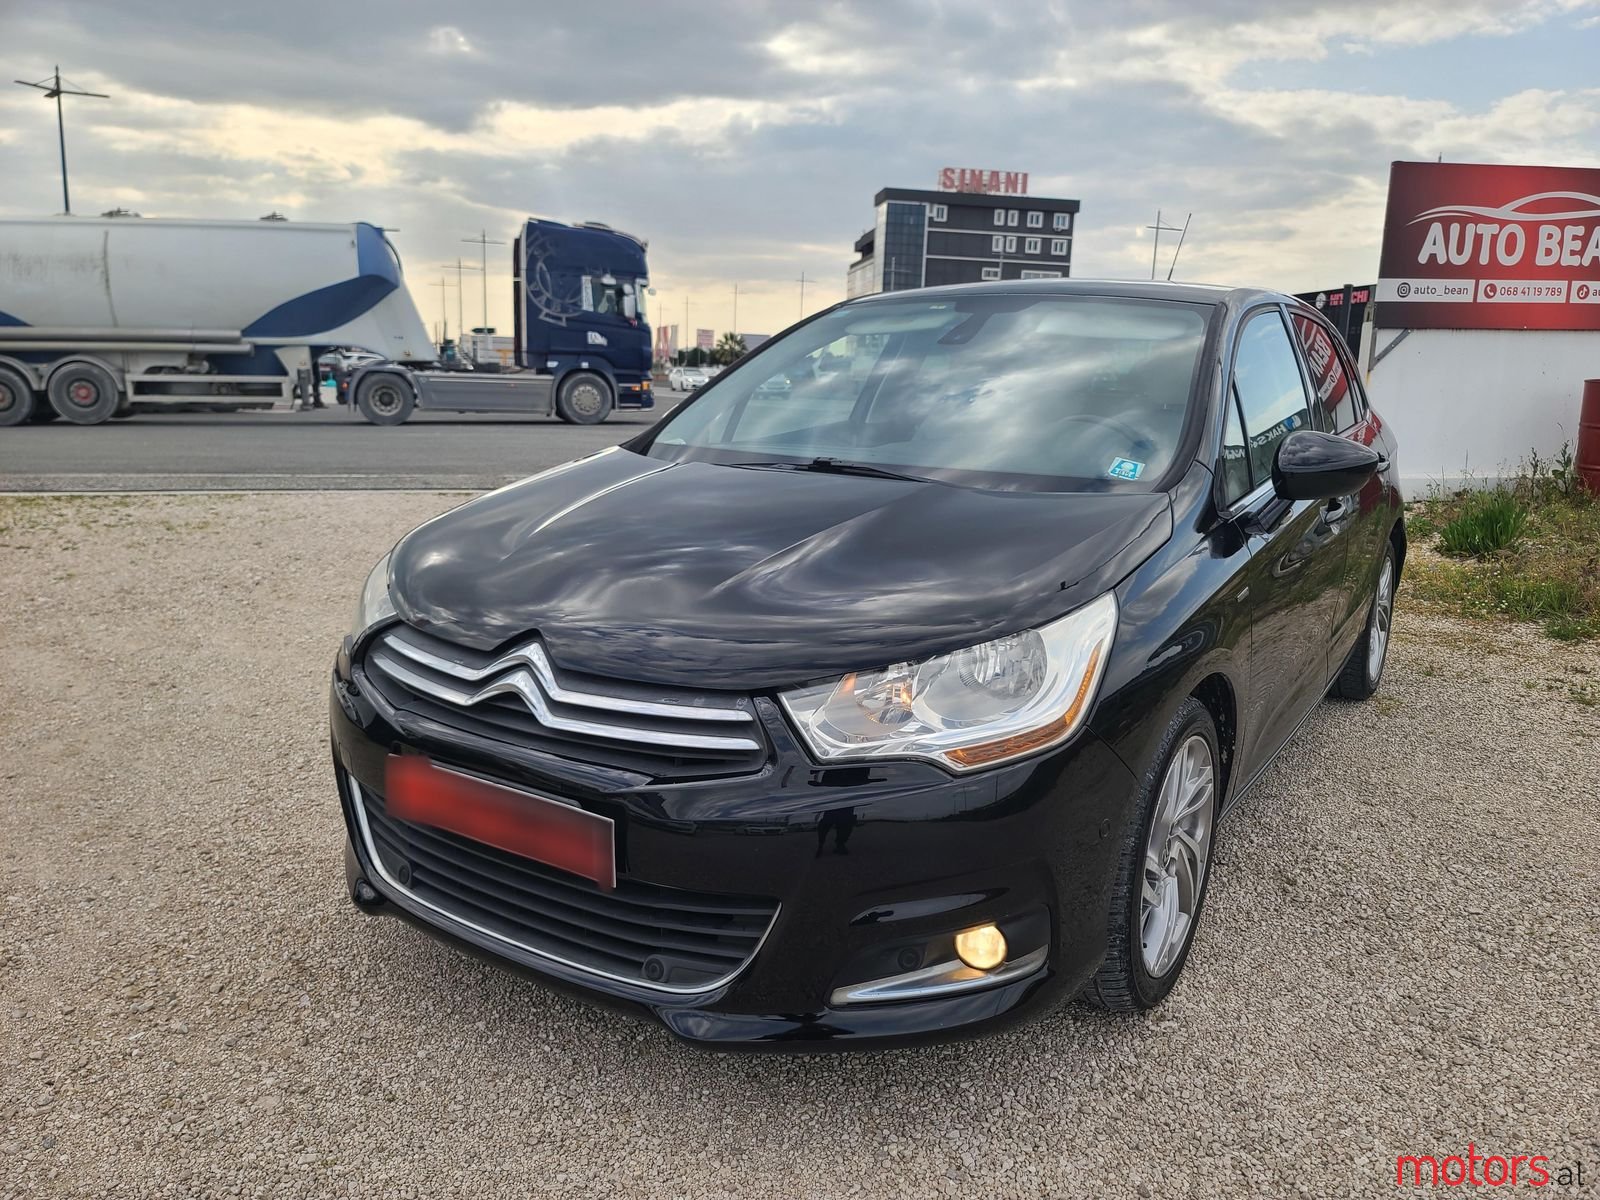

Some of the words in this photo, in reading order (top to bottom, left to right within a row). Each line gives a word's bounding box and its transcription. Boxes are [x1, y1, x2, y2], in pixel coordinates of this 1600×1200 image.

[942, 167, 1028, 194] SINANI
[1417, 221, 1526, 266] AUTO
[1535, 224, 1600, 267] BEA
[1329, 291, 1368, 305] HITCHI
[1413, 285, 1469, 297] auto_bean
[1500, 286, 1519, 297] 068
[1545, 287, 1562, 297] 789
